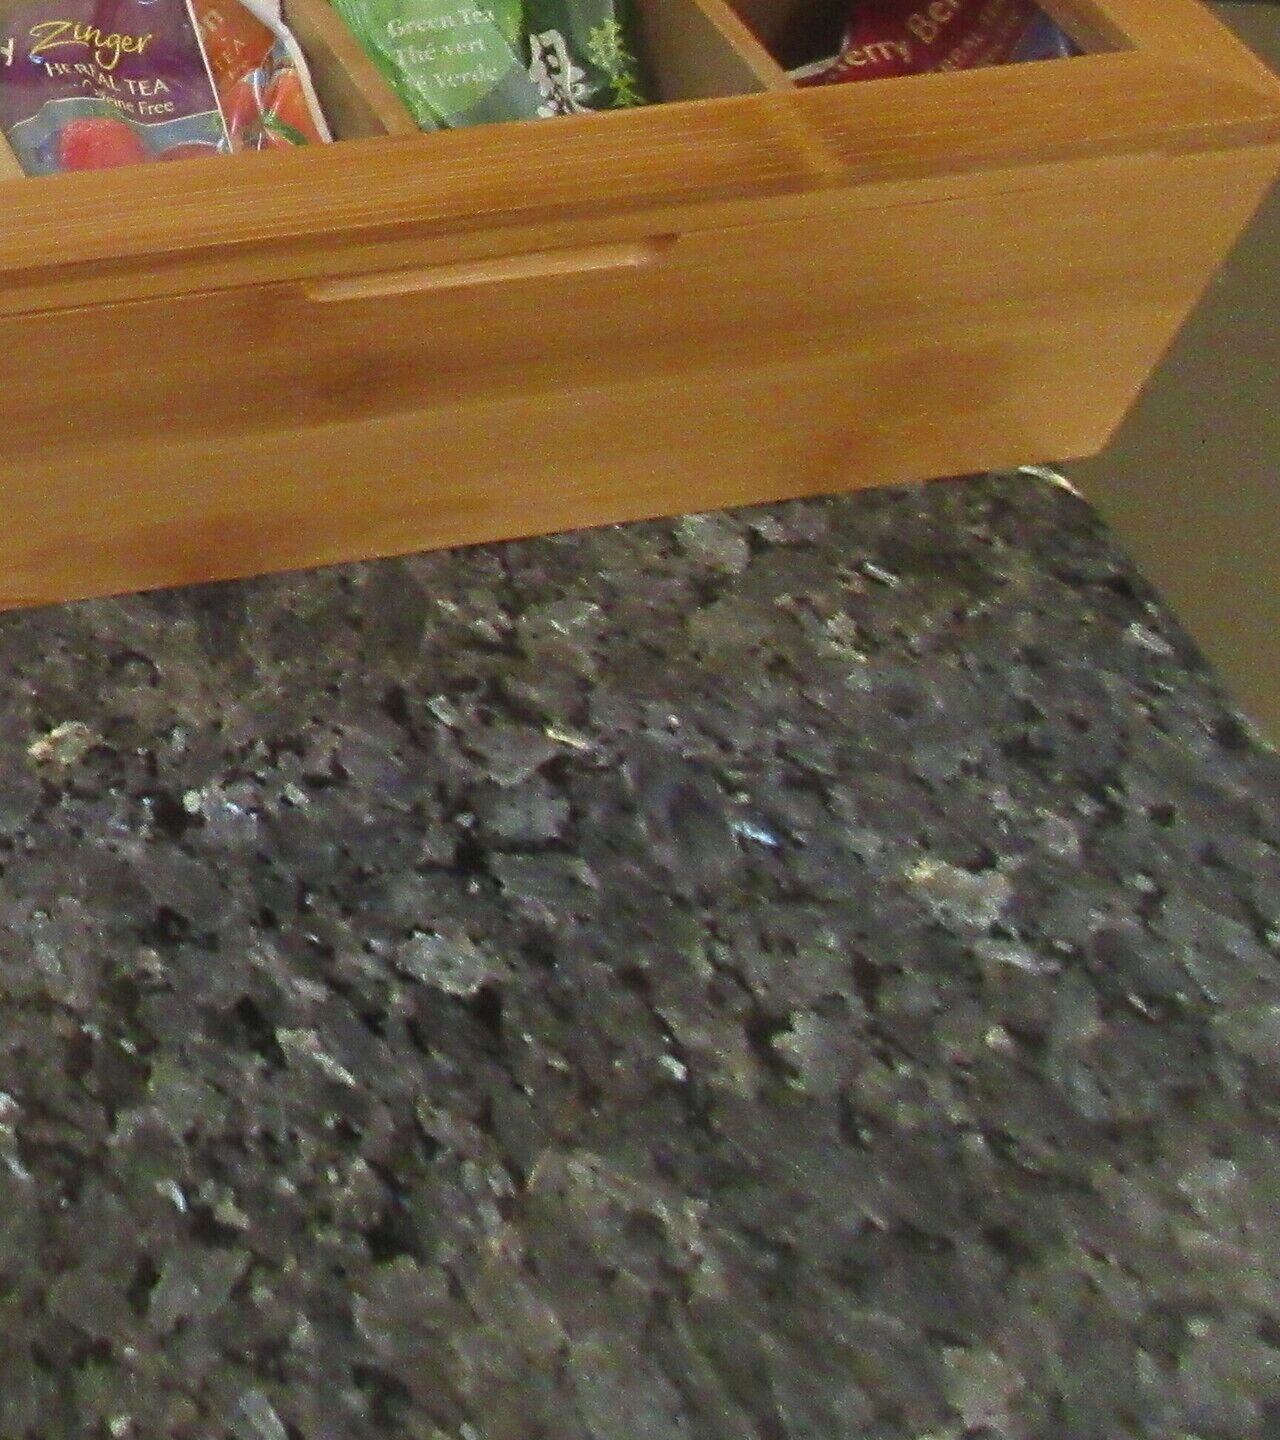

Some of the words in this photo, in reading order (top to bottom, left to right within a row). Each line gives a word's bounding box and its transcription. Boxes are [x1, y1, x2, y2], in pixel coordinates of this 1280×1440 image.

[28, 17, 155, 71] Zinger
[124, 77, 170, 97] TEA
[138, 101, 176, 116] Free
